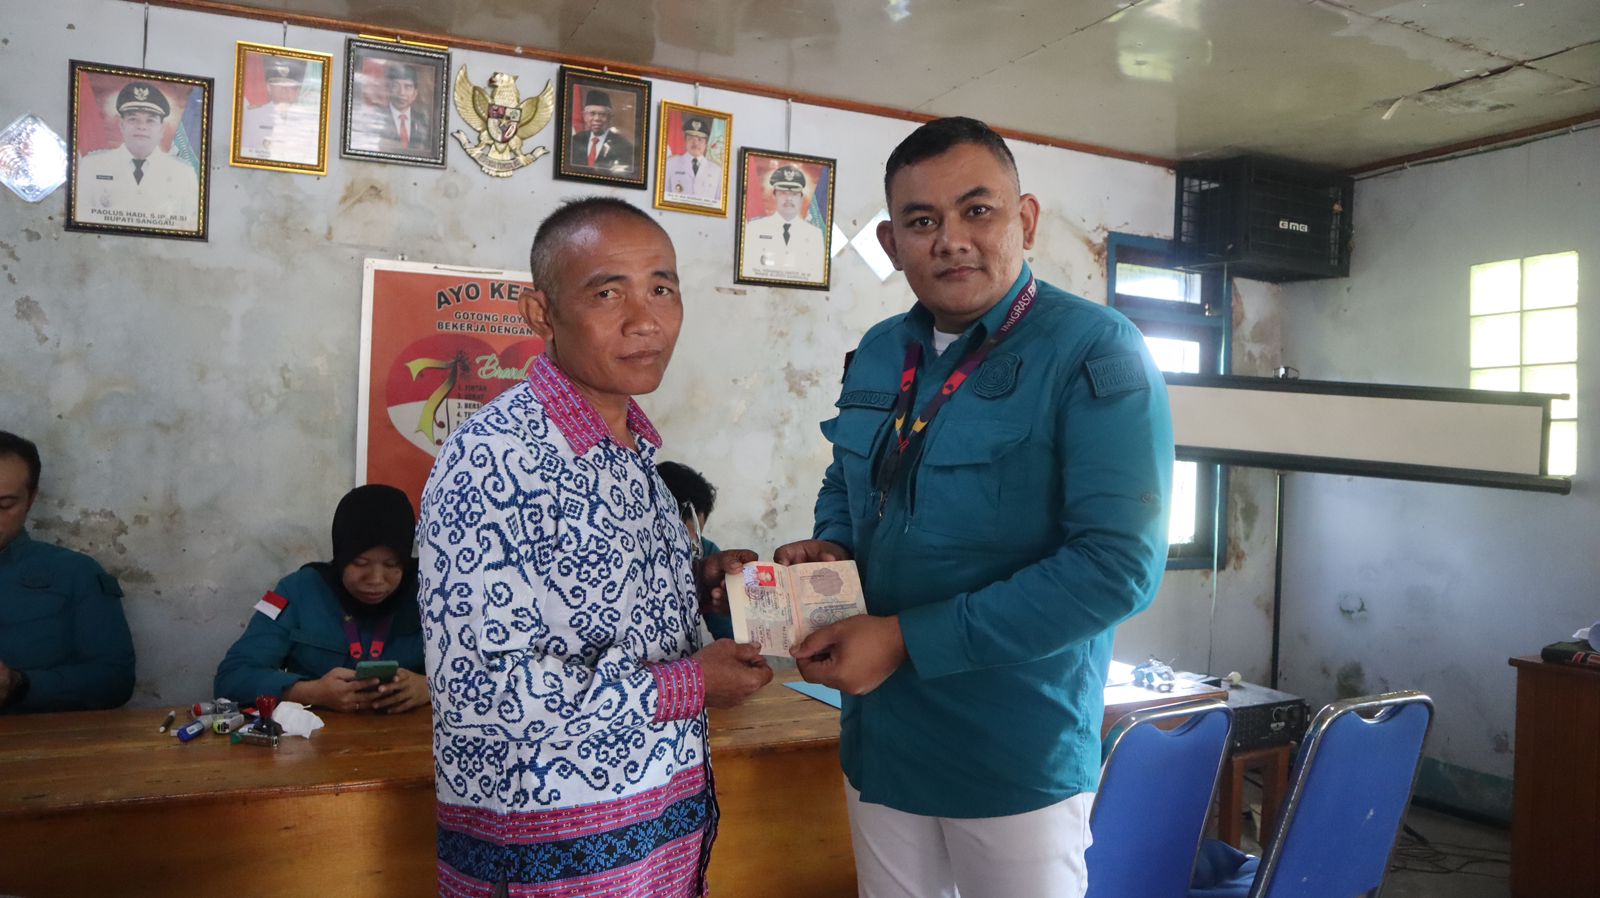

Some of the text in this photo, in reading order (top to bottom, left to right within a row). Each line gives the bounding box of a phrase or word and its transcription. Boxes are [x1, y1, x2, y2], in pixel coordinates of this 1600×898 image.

[91, 208, 124, 217] PAOLUS
[104, 215, 175, 226] BUPATI SANGGAU
[436, 282, 481, 310] AYO
[454, 311, 499, 322] GOTONG
[437, 321, 533, 336] BEKERJA DENGAN
